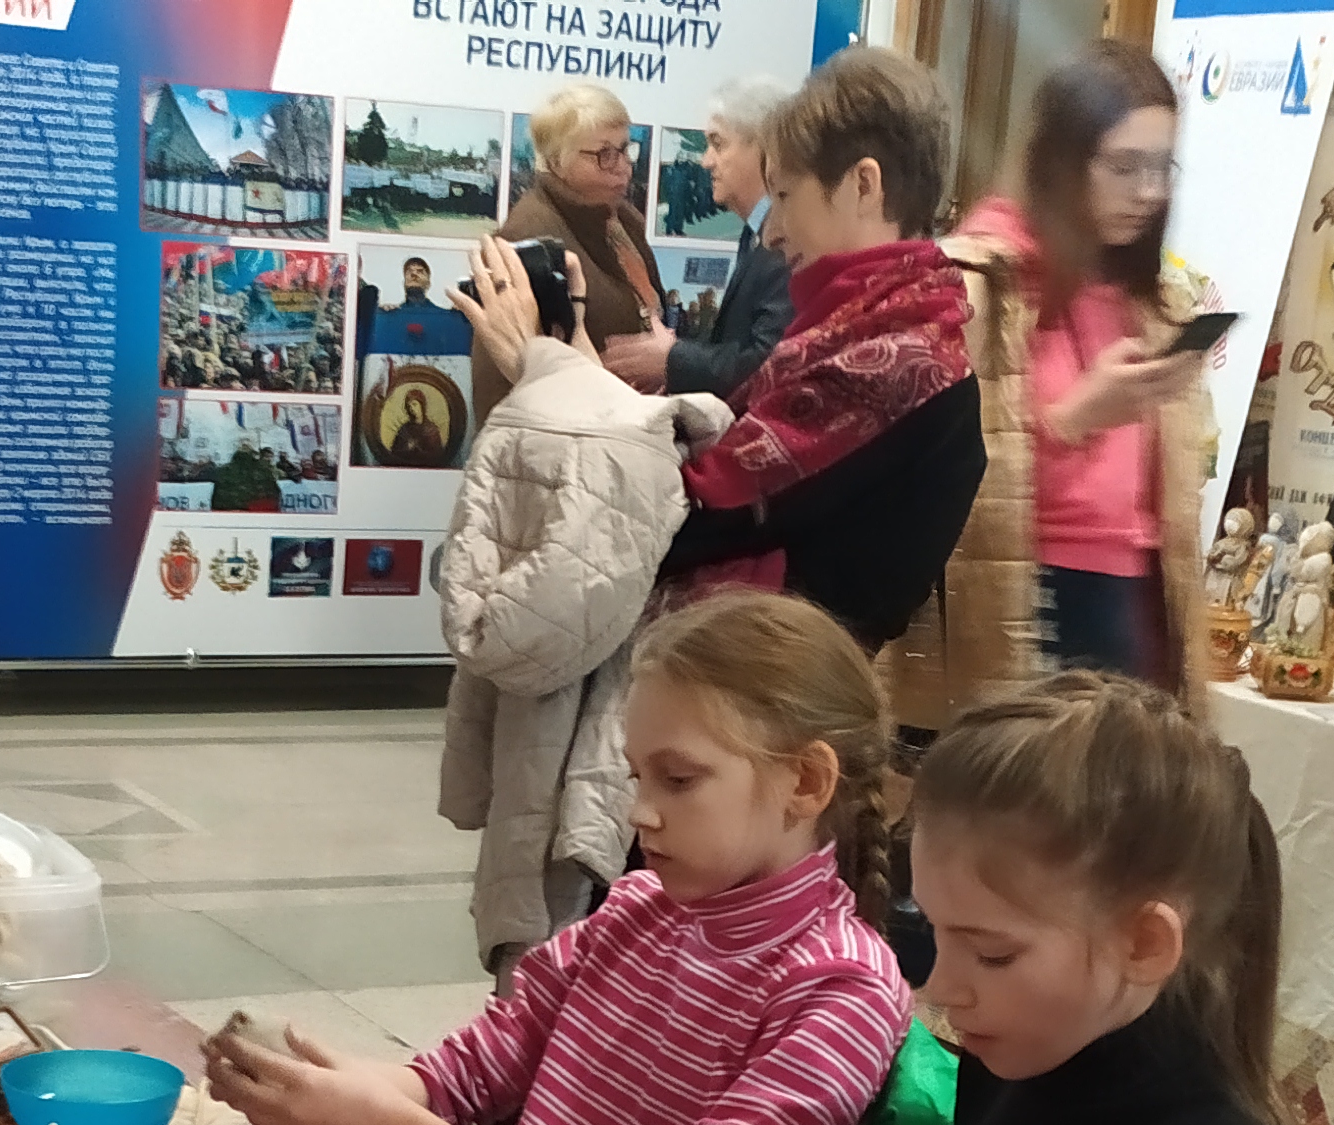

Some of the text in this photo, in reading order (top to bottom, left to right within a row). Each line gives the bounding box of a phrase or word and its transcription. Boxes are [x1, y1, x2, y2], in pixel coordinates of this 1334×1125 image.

[546, 2, 587, 38] НА
[596, 9, 723, 50] ЗАЩИТУ
[466, 33, 668, 85] РЕСПУБЛИКИ
